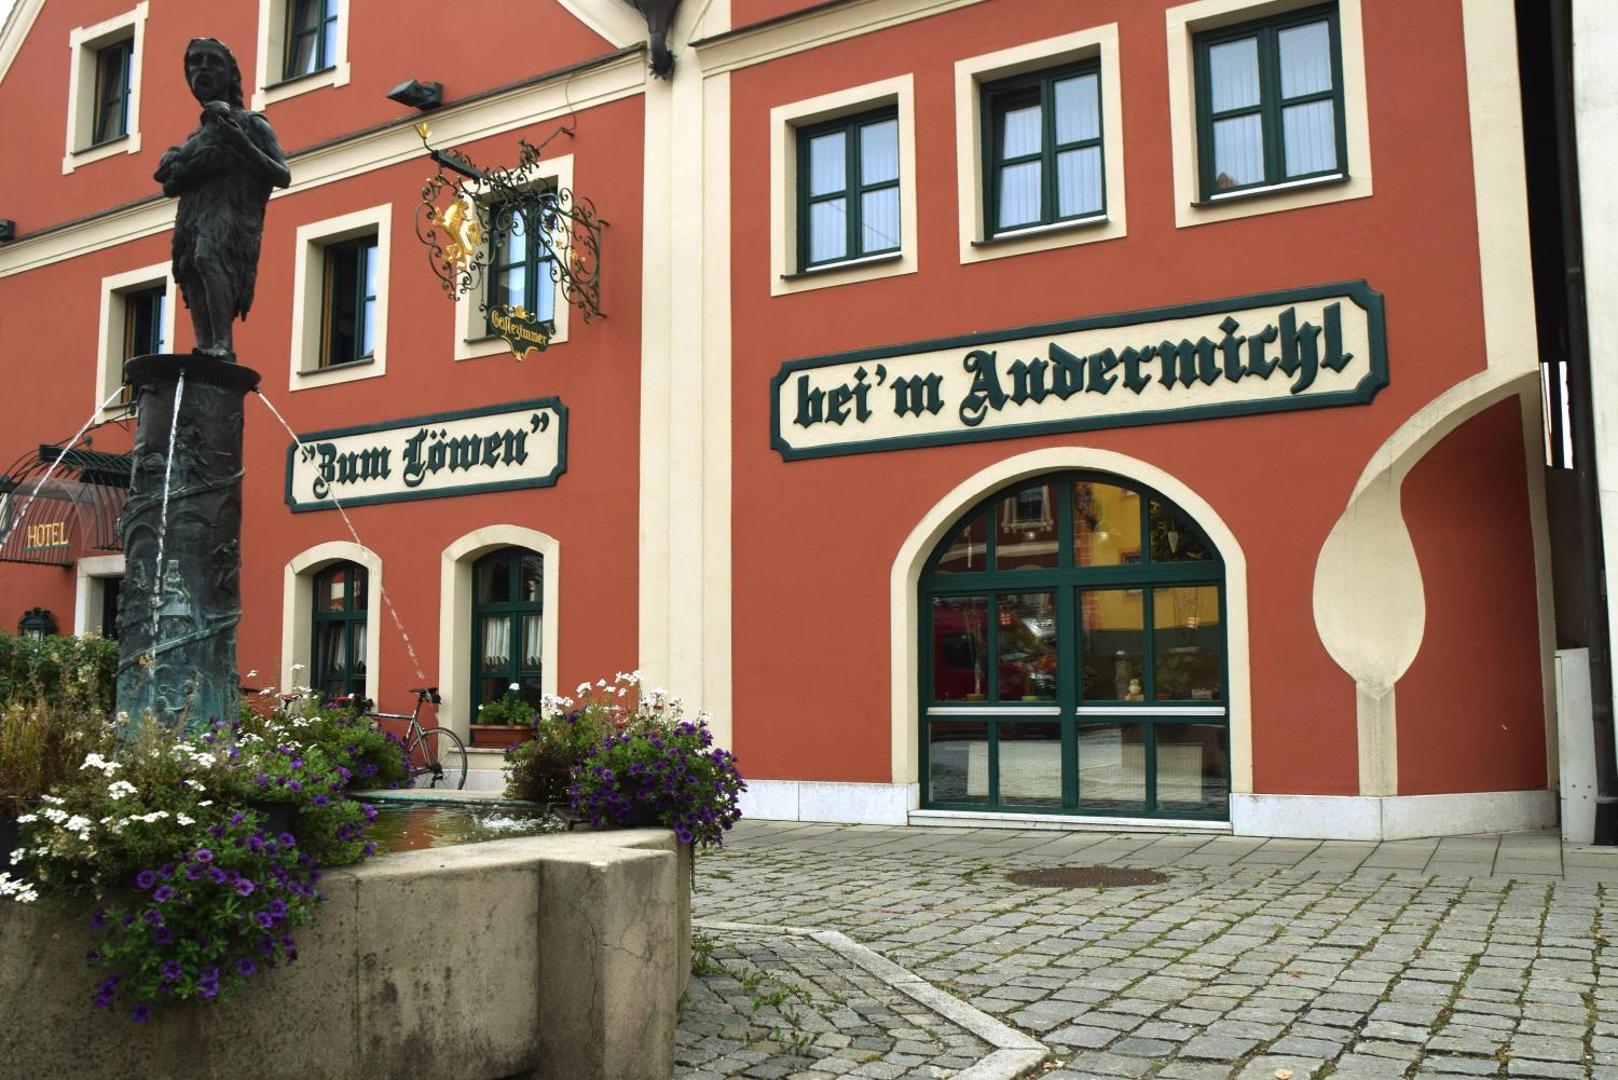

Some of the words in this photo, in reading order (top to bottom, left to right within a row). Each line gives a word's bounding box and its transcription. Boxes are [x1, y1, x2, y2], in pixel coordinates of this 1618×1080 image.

[792, 363, 944, 429] bei’m
[959, 302, 1354, 426] Andermichl
[27, 521, 69, 548] HOTEL
